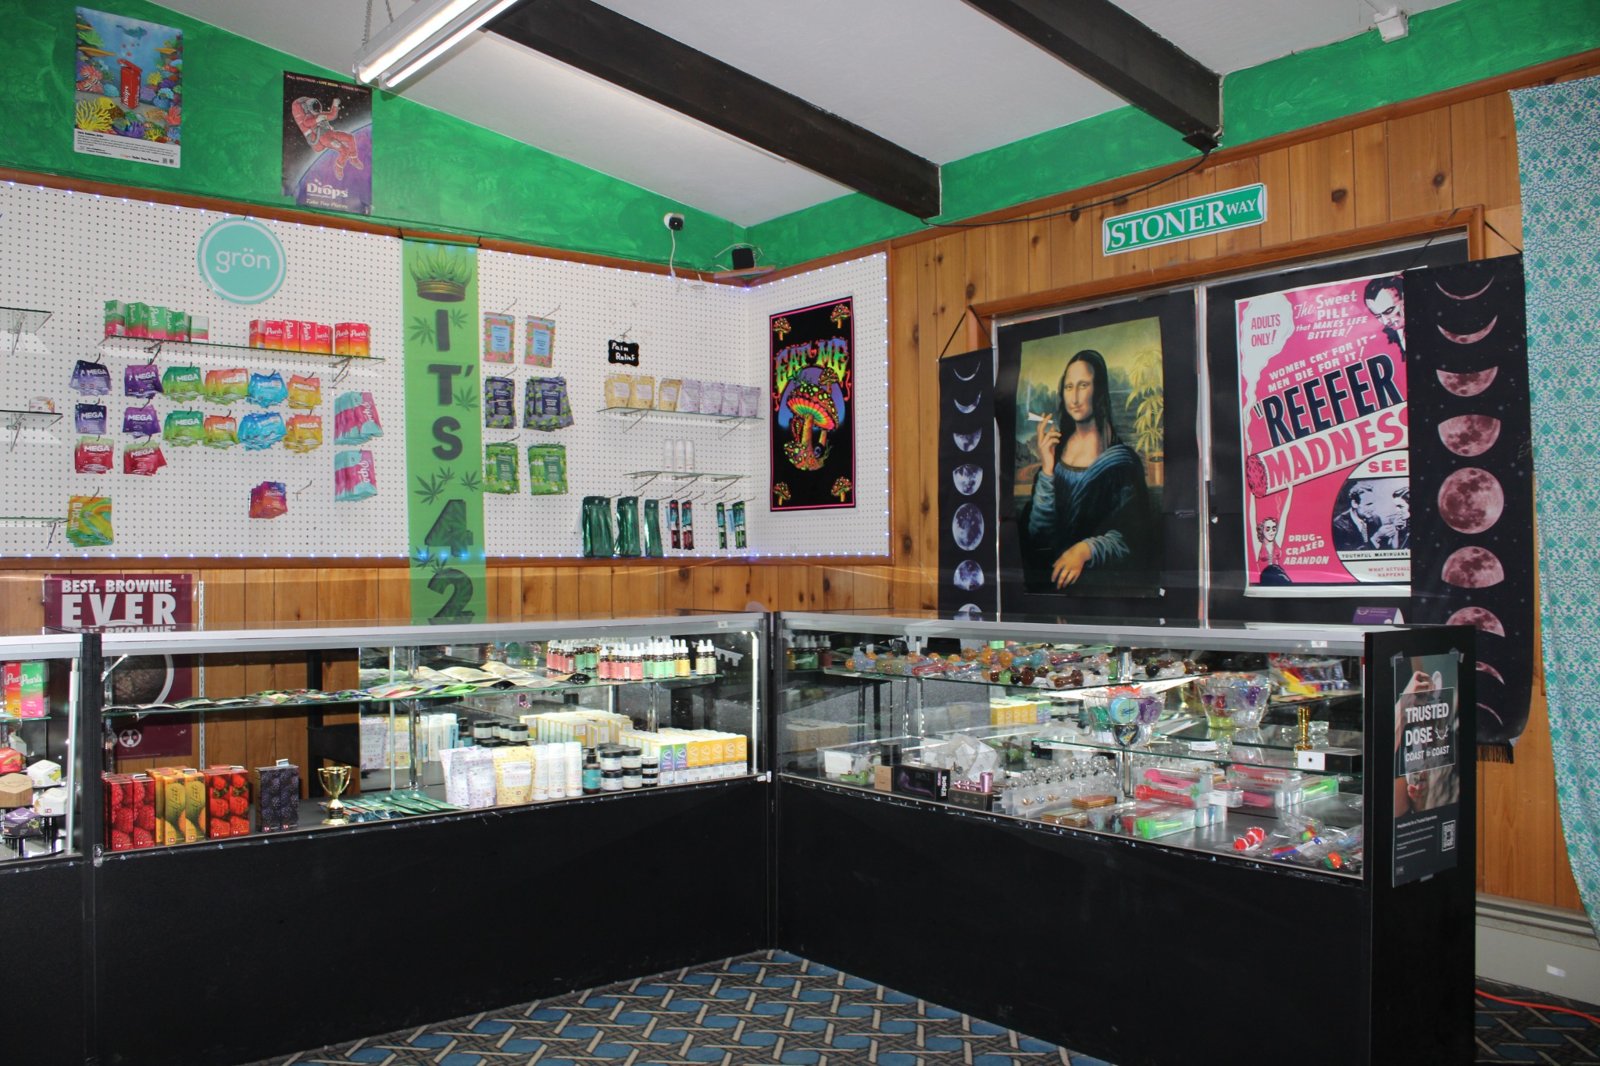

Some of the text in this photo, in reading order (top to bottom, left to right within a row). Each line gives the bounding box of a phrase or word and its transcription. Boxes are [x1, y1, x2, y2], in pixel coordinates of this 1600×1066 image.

[306, 179, 349, 199] Drops
[1111, 199, 1256, 248] STONER WAY
[215, 247, 271, 274] grön
[1294, 290, 1357, 319] The Sweet
[1317, 306, 1349, 321] PILL
[1251, 314, 1281, 330] ADULTS
[1296, 316, 1368, 331] that MAKES LIFE
[1251, 329, 1277, 347] ONLY!
[1308, 325, 1352, 340] BITTER!
[611, 341, 629, 352] Pain
[1269, 359, 1306, 380] WOMEN
[1310, 351, 1329, 365] CRY
[1332, 342, 1353, 356] FOR
[135, 371, 156, 382] MEGA
[774, 343, 813, 396] EAT
[1268, 346, 1365, 393] MEN DIE FOR IT!
[176, 373, 200, 382] MEGA
[81, 411, 104, 421] MEGA
[127, 413, 152, 422] MEGA
[175, 418, 200, 427] MEGA
[83, 445, 110, 454] MEGA
[130, 447, 155, 458] MEGA
[1368, 459, 1407, 473] SEE
[1288, 533, 1322, 543] DRUG-
[1286, 540, 1325, 556] CRAZED
[1283, 556, 1329, 566] ABANDON
[62, 579, 177, 593] BEST. BROWNIE.
[61, 593, 177, 627] EVER
[1405, 702, 1449, 723] TRUSTED
[1405, 726, 1433, 746] DOSE
[1404, 750, 1425, 761] COAST
[1432, 745, 1450, 756] COAST
